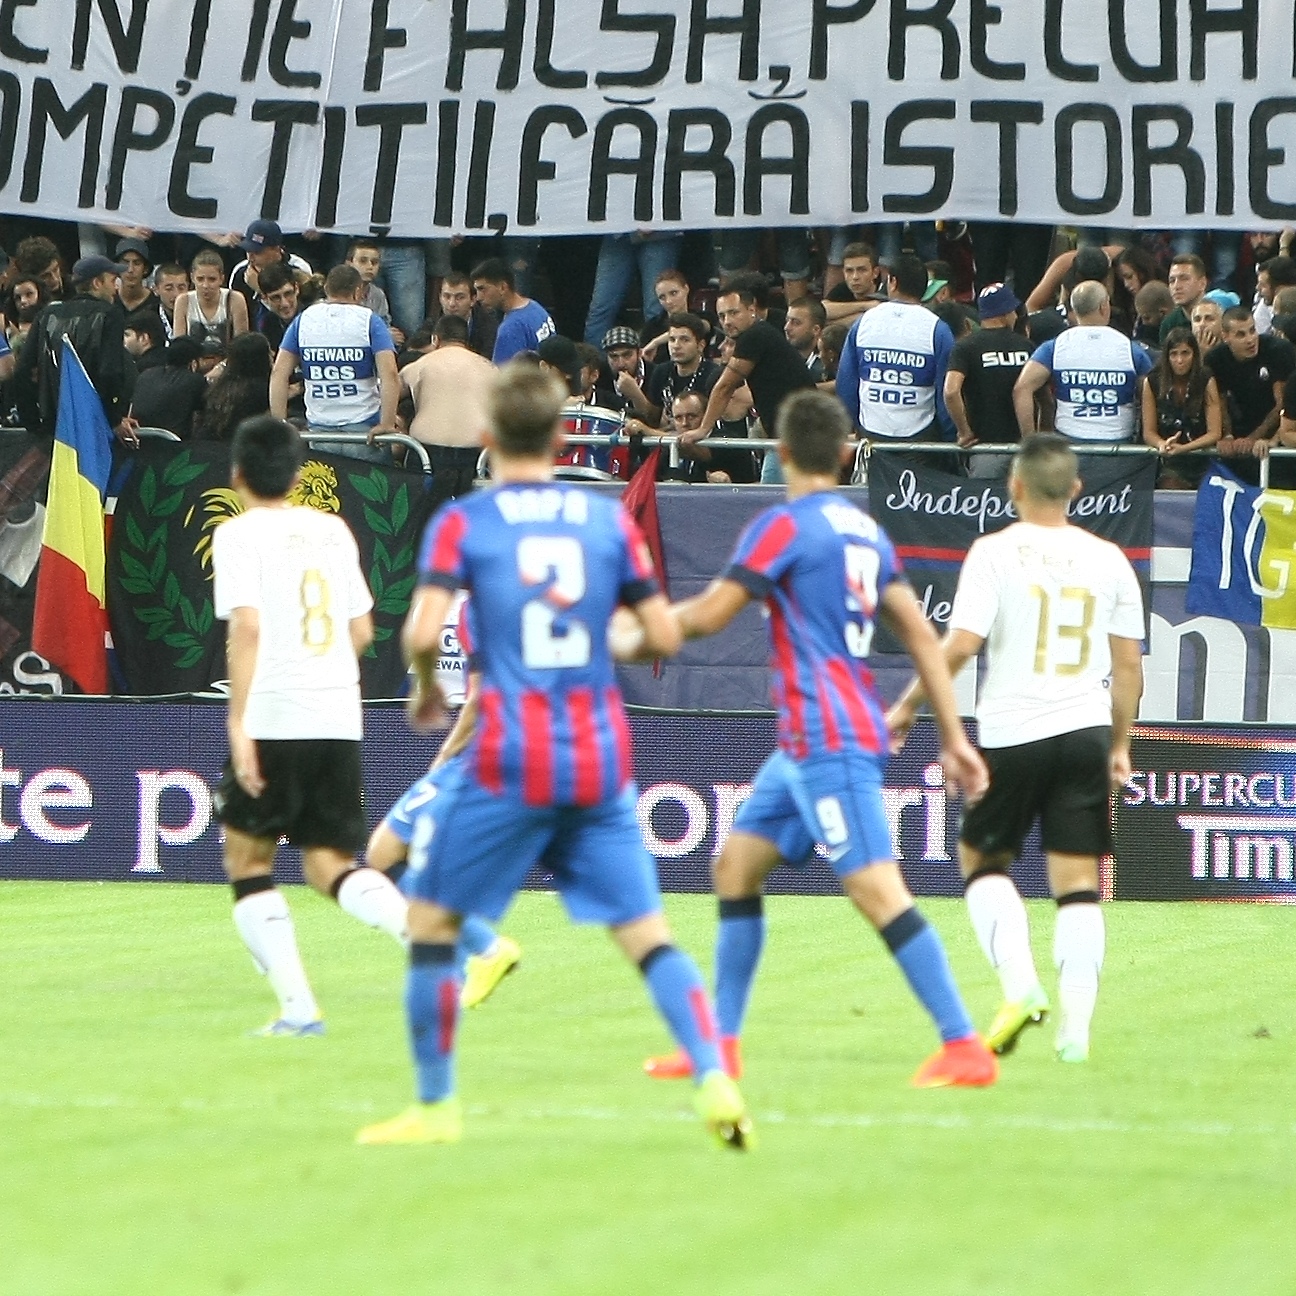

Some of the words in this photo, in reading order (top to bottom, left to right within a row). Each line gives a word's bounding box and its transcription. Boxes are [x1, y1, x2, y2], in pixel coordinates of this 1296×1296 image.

[302, 347, 364, 362] STEWARD
[863, 348, 926, 369] STEWARD
[981, 351, 1029, 368] SUD
[309, 365, 356, 381] BGS
[869, 367, 914, 386] BGS
[1060, 369, 1127, 386] STEWARD
[311, 383, 358, 399] 259
[867, 387, 917, 406] 302
[1068, 387, 1119, 405] BGS
[885, 468, 1132, 534] Indepeent
[516, 534, 592, 670] 2
[299, 567, 334, 658] 8
[1028, 584, 1097, 677] 13
